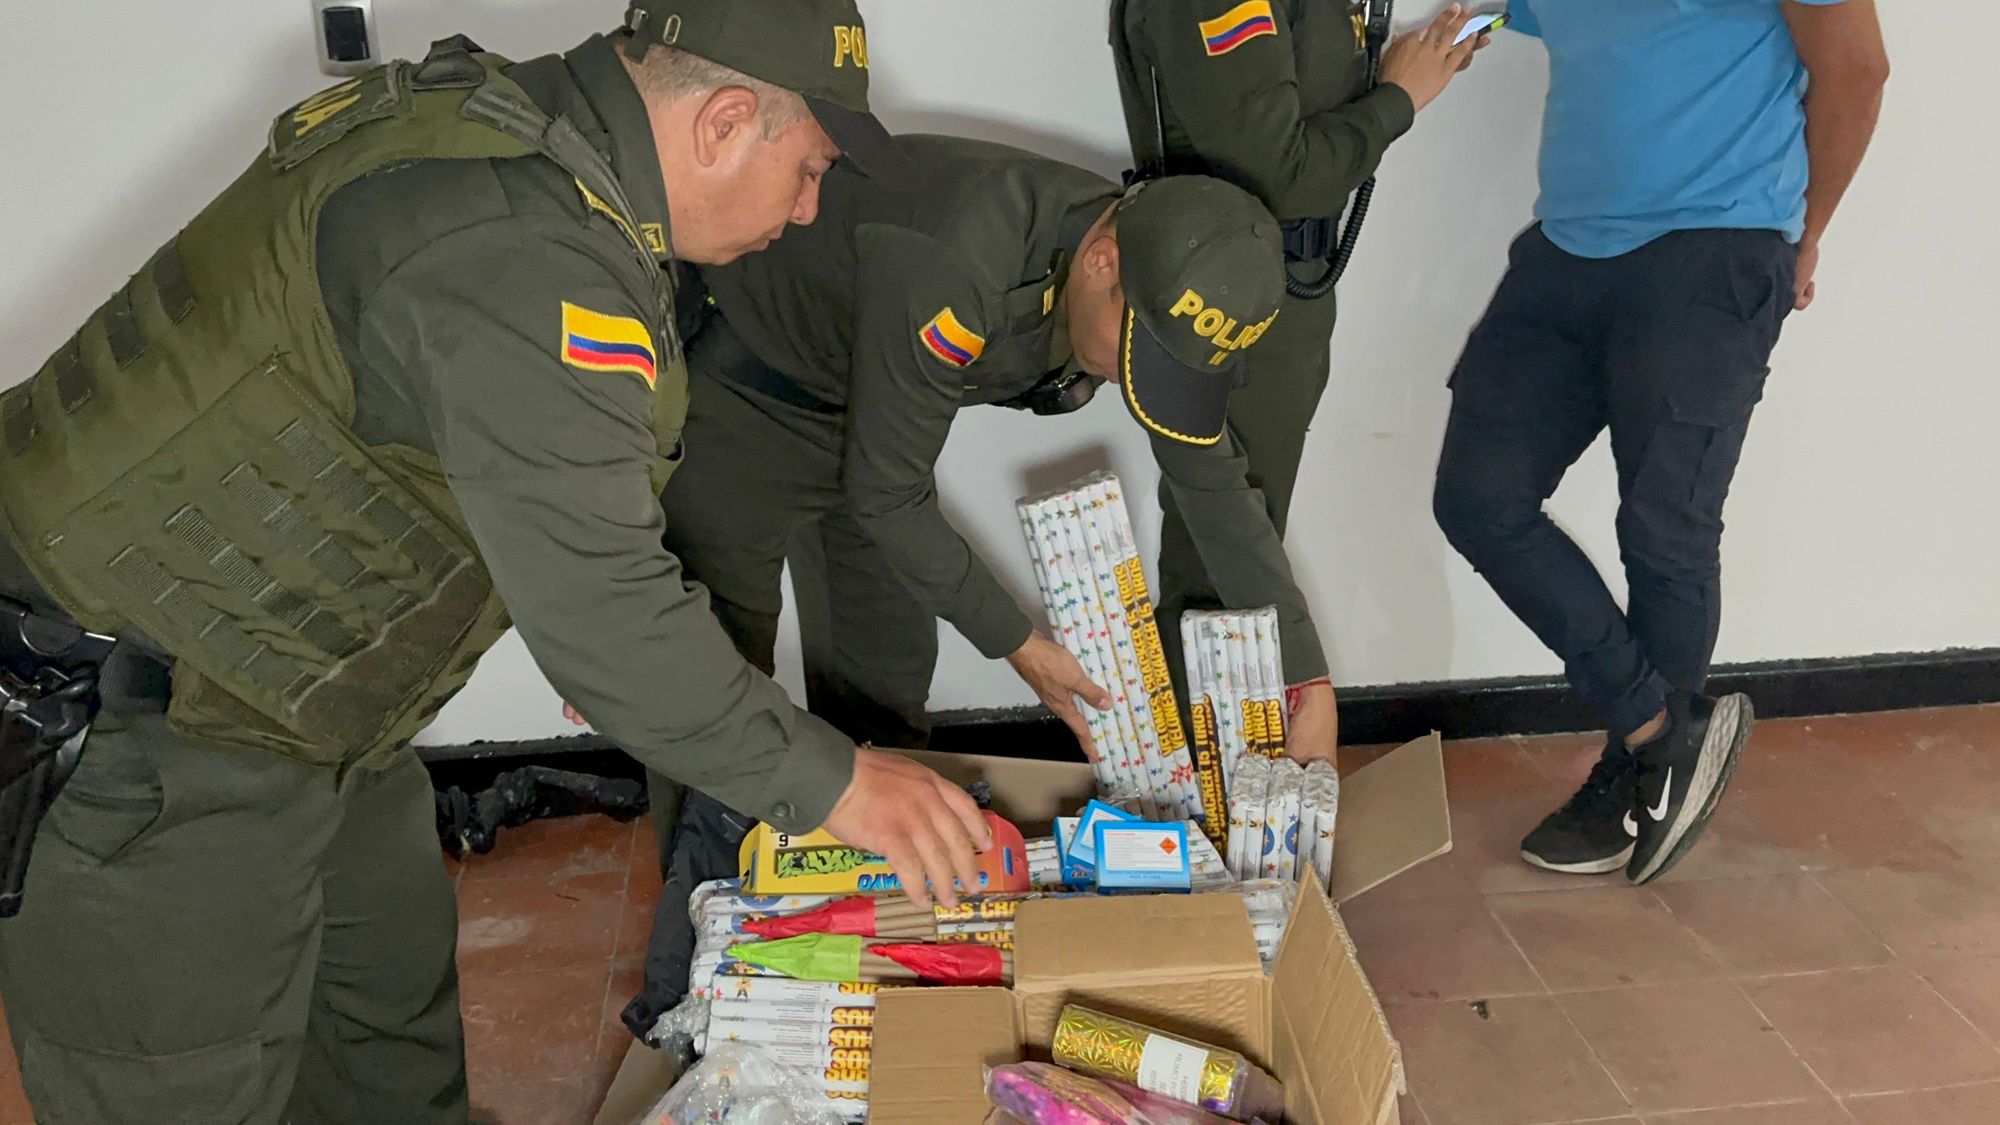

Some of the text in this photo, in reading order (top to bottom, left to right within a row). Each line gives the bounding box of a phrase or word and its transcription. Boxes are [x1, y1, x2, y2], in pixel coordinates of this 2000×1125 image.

[1113, 562, 1136, 609] TIROS
[1126, 609, 1141, 628] 15
[1126, 556, 1185, 751] VELONES CRACKER 15 TIROS
[1131, 627, 1158, 694] CRACKER
[1191, 703, 1209, 746] TIROS
[1267, 699, 1284, 742] TIROS
[1198, 750, 1211, 767] 15
[1200, 769, 1221, 837] CRACKER
